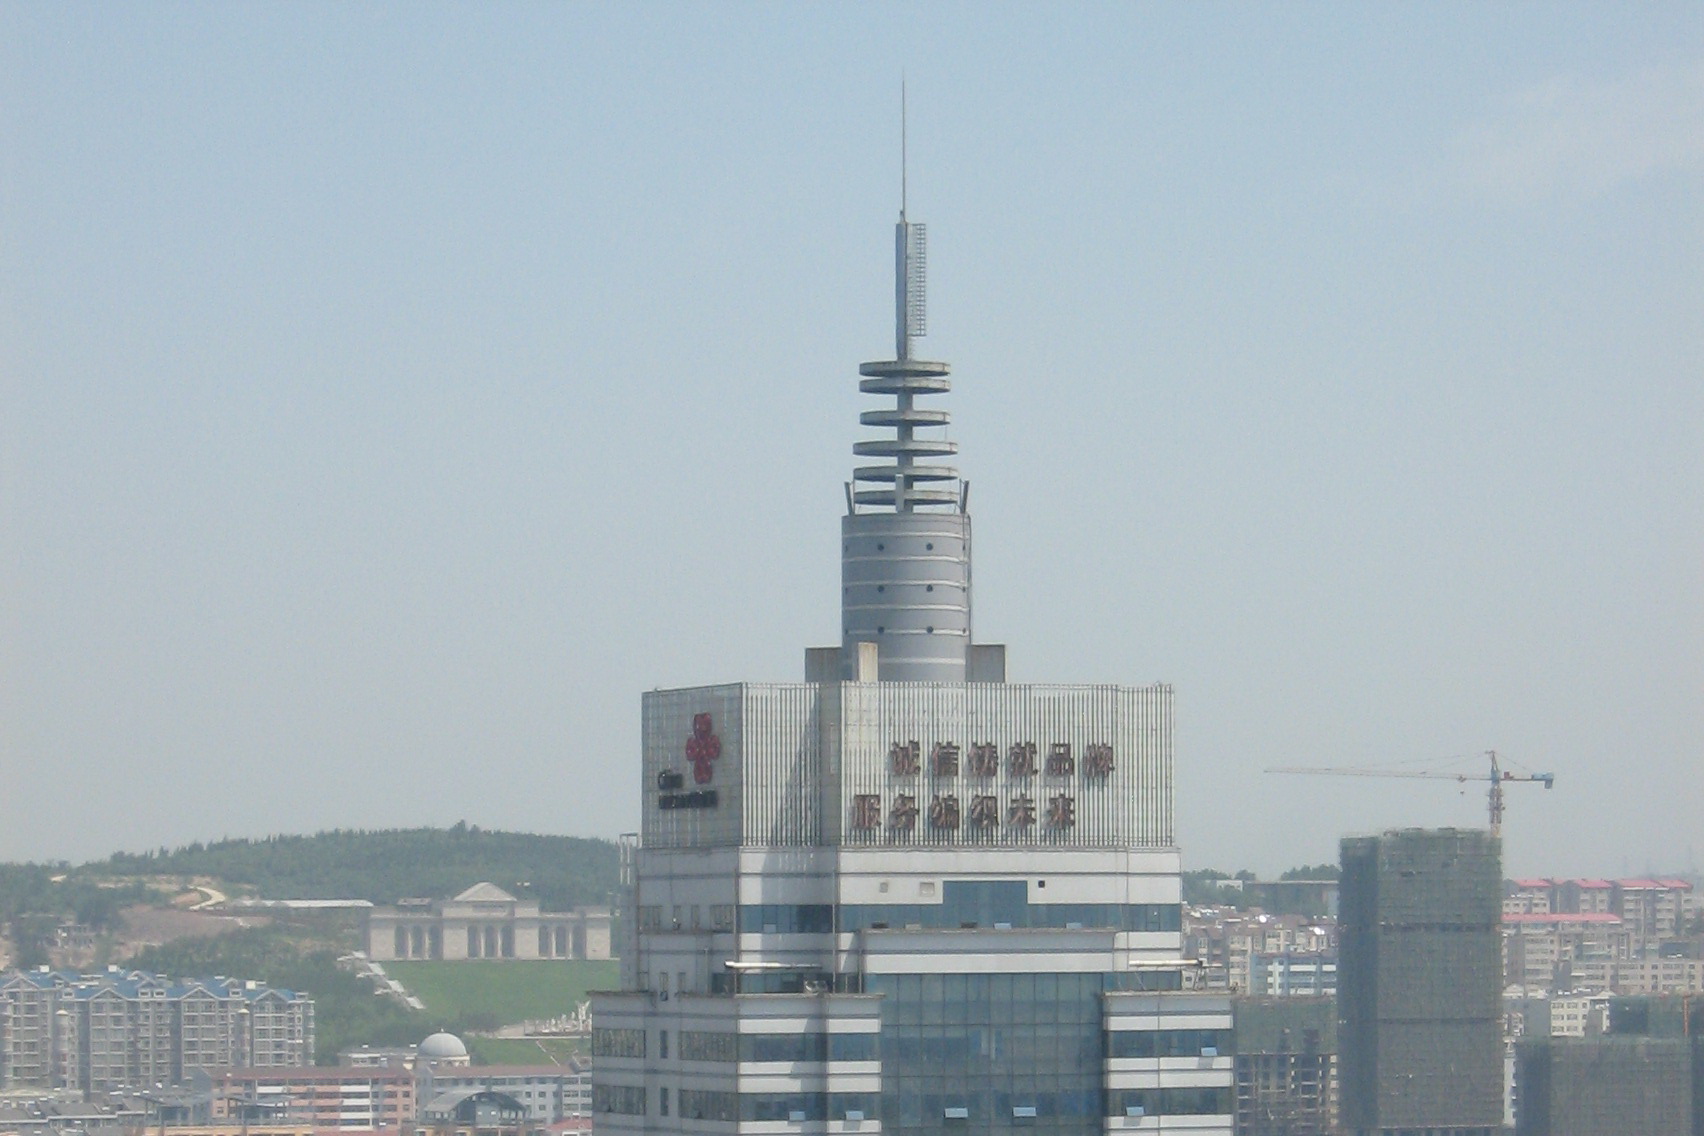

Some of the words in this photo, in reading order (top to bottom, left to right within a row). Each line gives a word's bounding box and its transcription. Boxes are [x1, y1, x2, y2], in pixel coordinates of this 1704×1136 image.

[851, 793, 1075, 830] 服务编织未来
